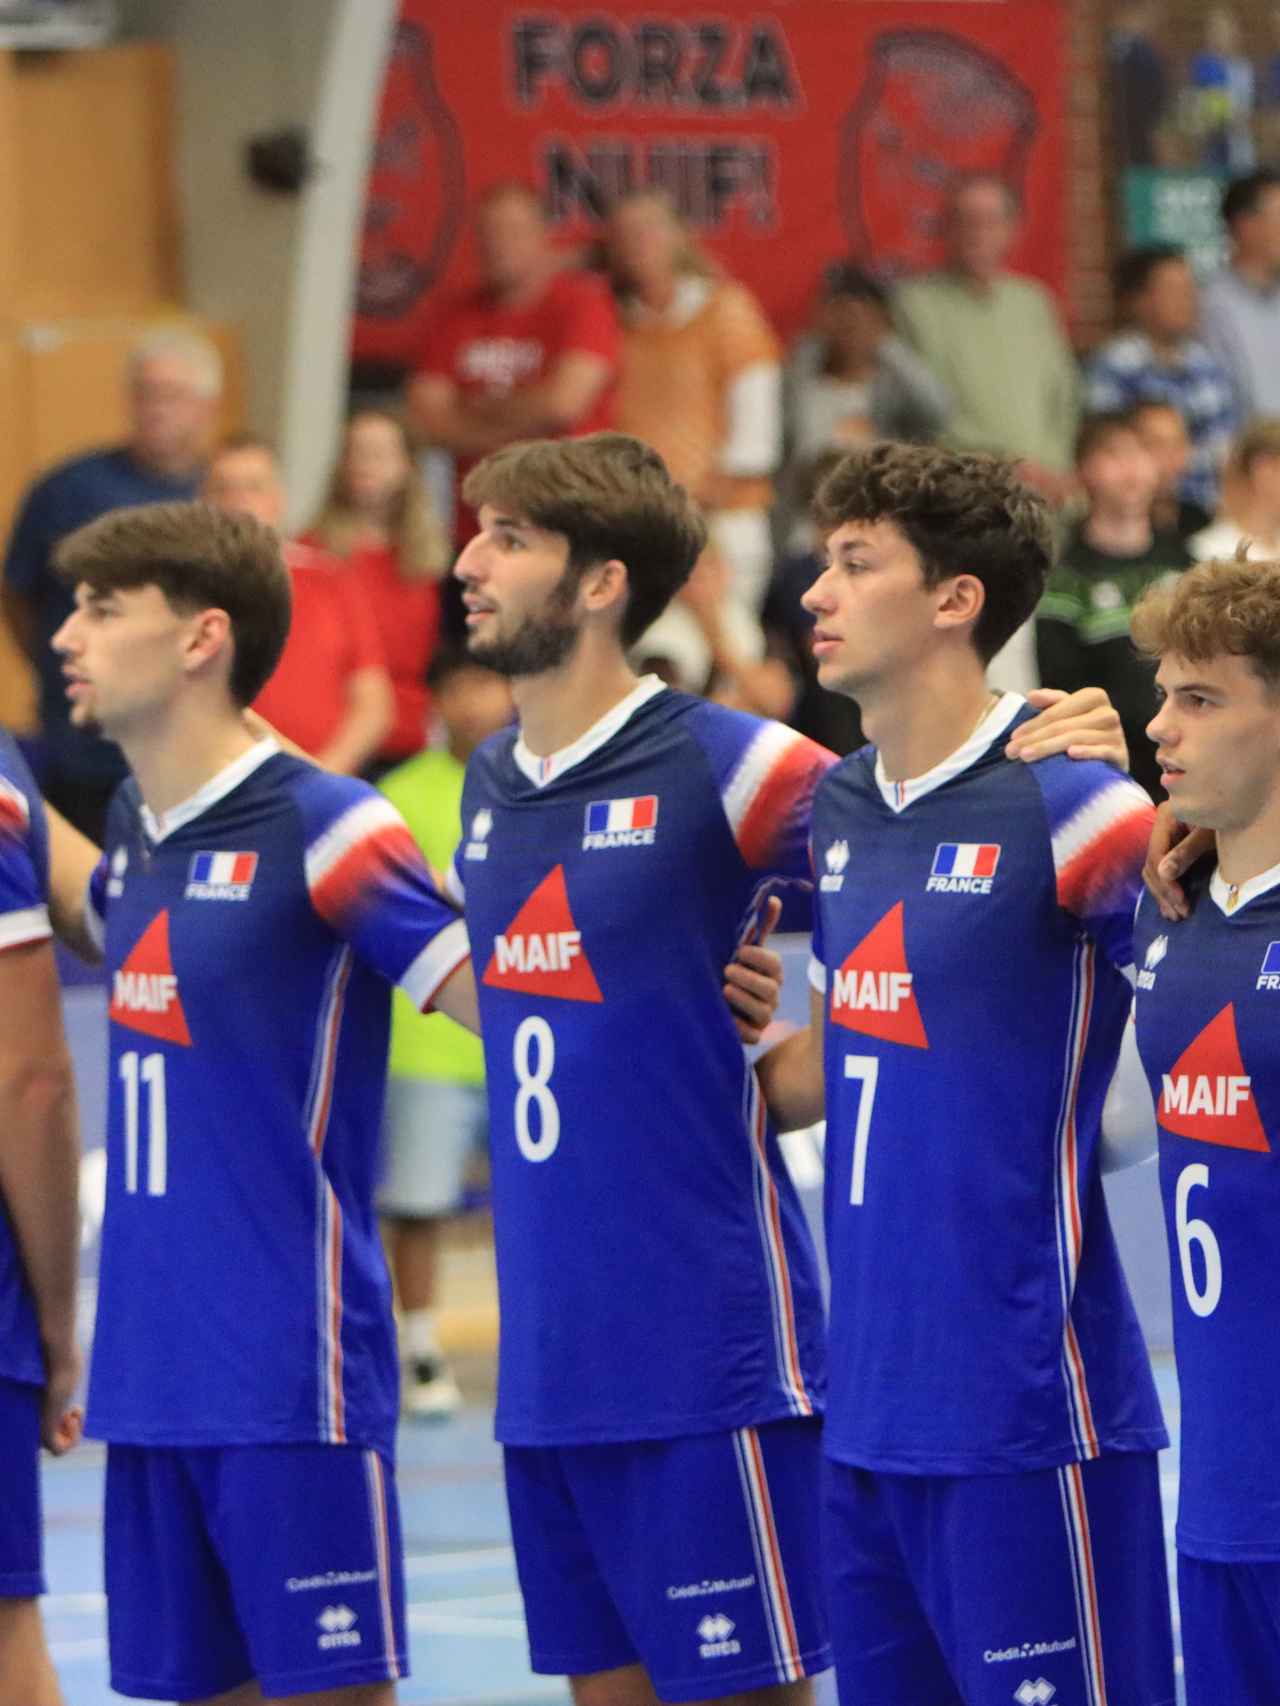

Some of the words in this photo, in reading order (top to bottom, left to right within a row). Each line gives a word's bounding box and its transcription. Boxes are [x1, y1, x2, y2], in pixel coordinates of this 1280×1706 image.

[511, 20, 794, 107] FORZA
[583, 829, 656, 851] FRANCE
[185, 883, 251, 901] FRANCE
[926, 877, 992, 894] FRANCE
[495, 931, 581, 974] MAIF
[113, 970, 178, 1013] MAIF
[833, 969, 912, 1012] MAIF
[513, 1015, 561, 1163] 8
[1162, 1073, 1250, 1116] MAIF
[119, 1051, 168, 1197] 11
[844, 1054, 879, 1206] 7
[1175, 1163, 1222, 1318] 6
[984, 1646, 1020, 1663] Crédit
[1034, 1637, 1076, 1654] Mutuel
